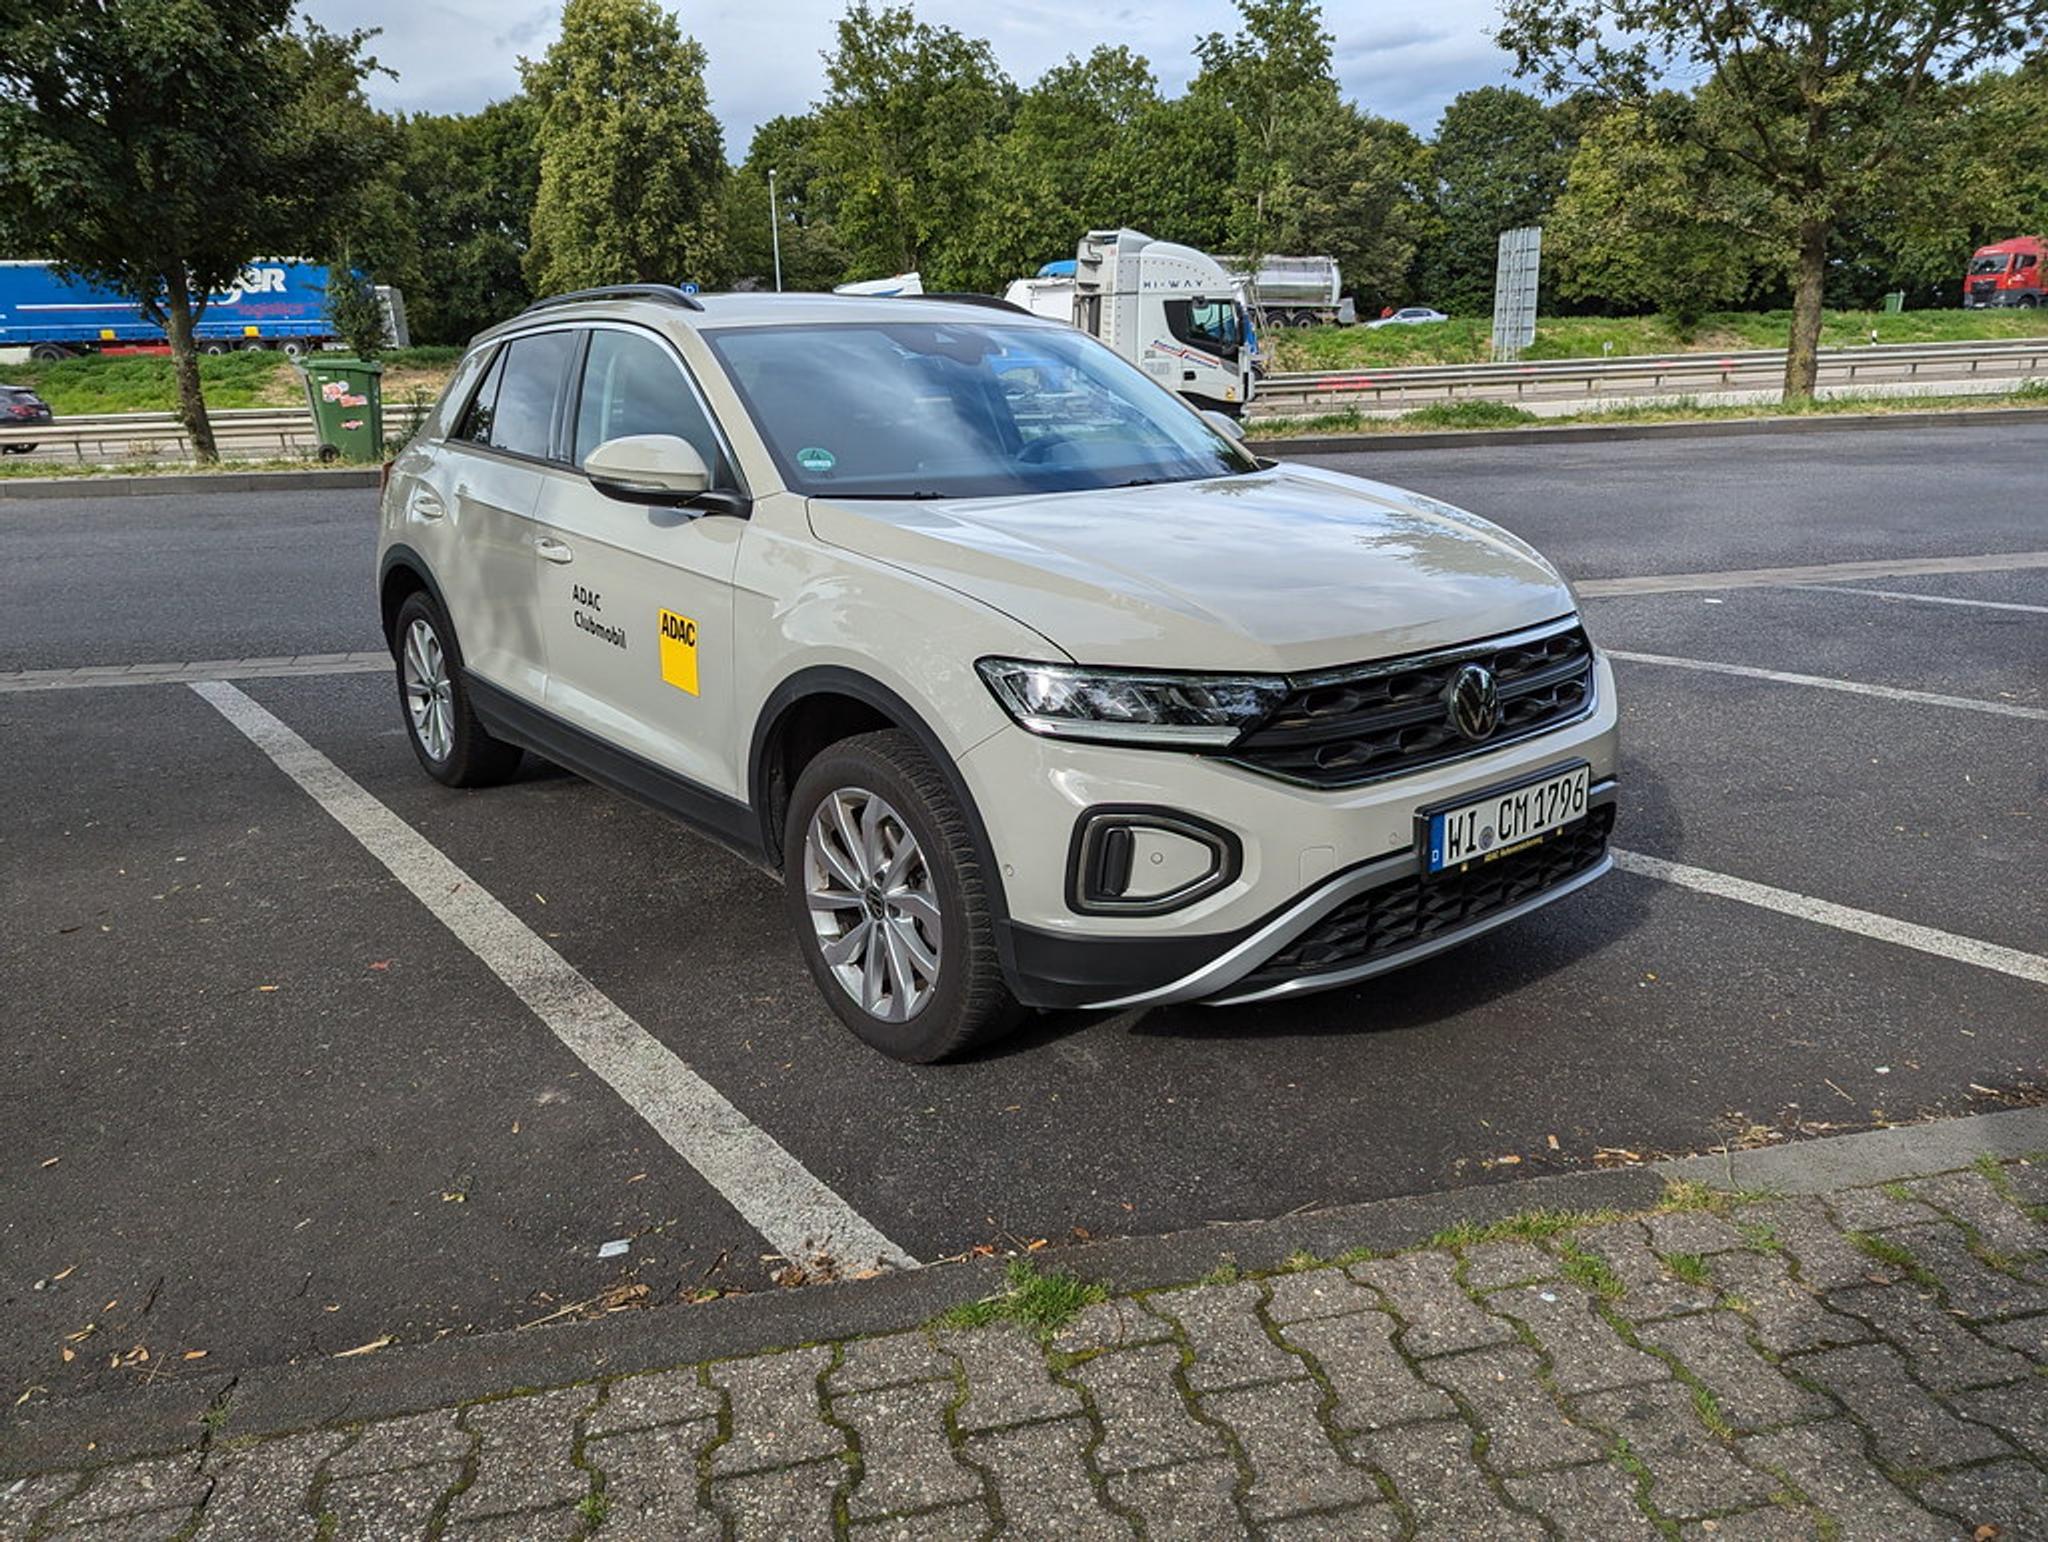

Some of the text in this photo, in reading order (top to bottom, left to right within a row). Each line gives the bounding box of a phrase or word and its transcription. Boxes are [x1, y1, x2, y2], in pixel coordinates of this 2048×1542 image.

[573, 584, 601, 611] ADAC
[574, 609, 627, 649] Clubmobil
[661, 612, 696, 647] ADAC
[1448, 811, 1477, 859] WI
